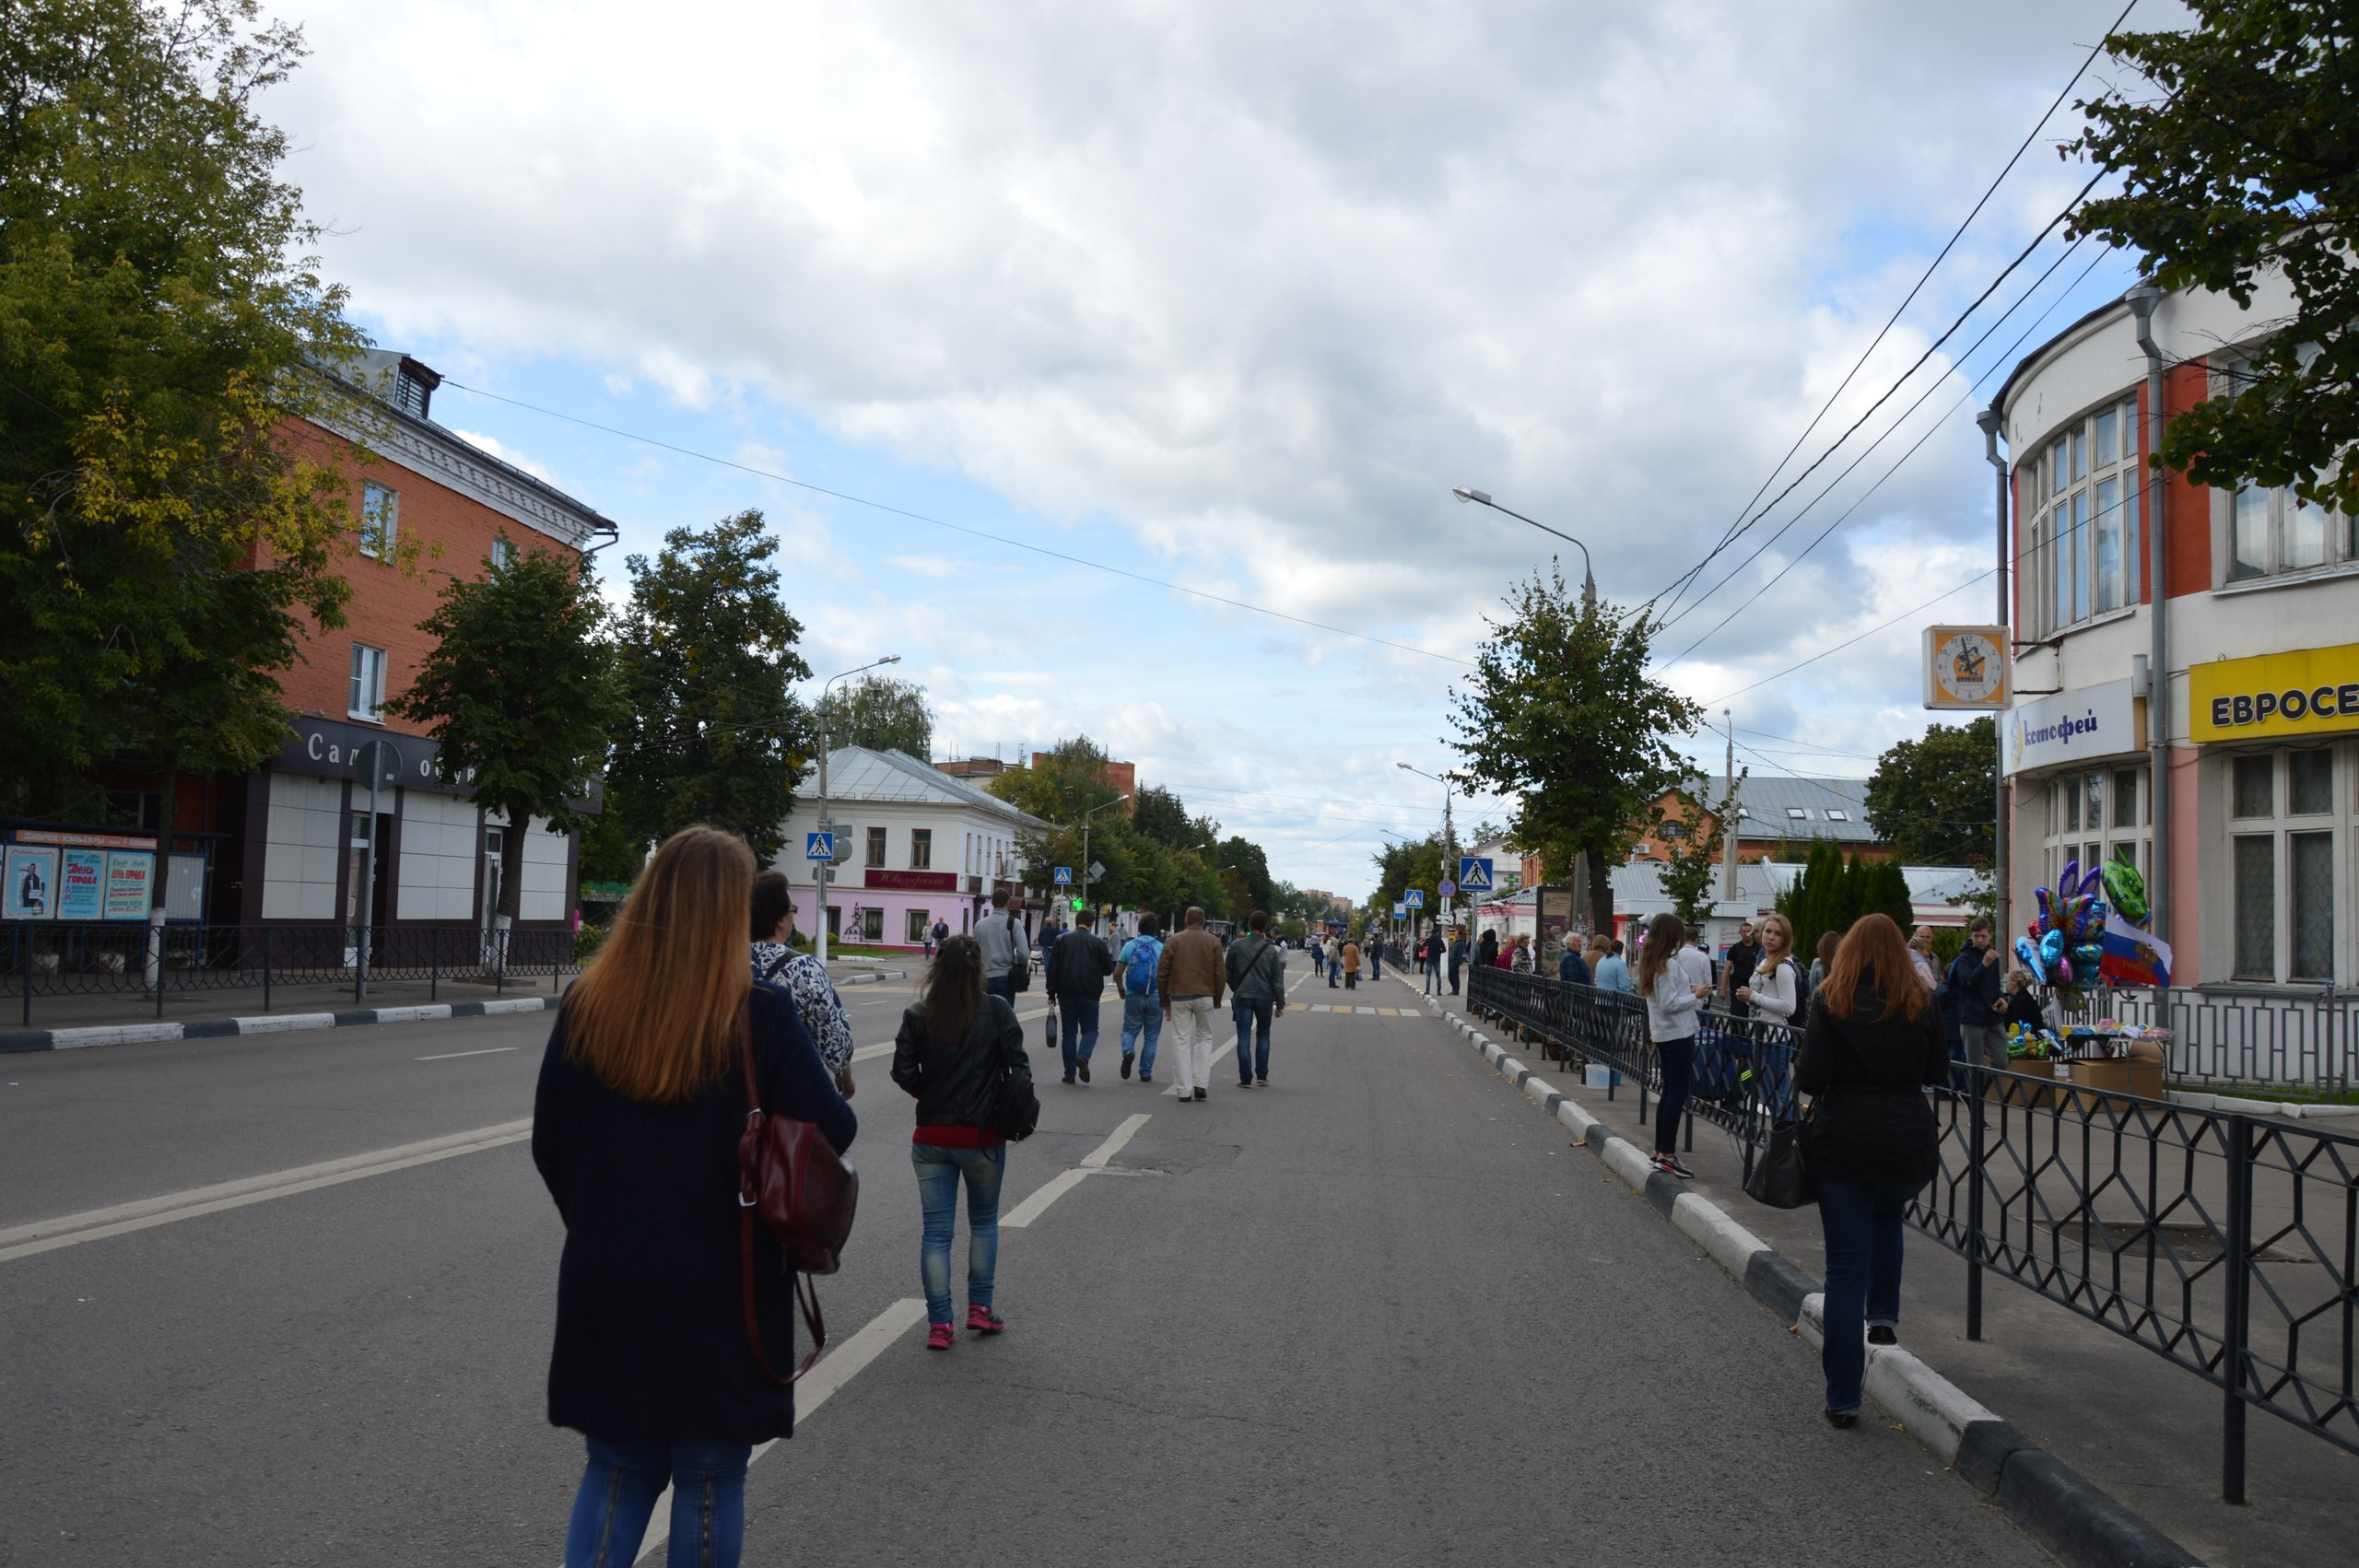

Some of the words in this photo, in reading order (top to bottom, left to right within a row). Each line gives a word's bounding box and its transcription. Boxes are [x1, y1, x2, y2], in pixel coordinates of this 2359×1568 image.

[2212, 683, 2359, 727] ЕВРОСЕ
[2024, 708, 2097, 746] котофей
[67, 862, 94, 875] День
